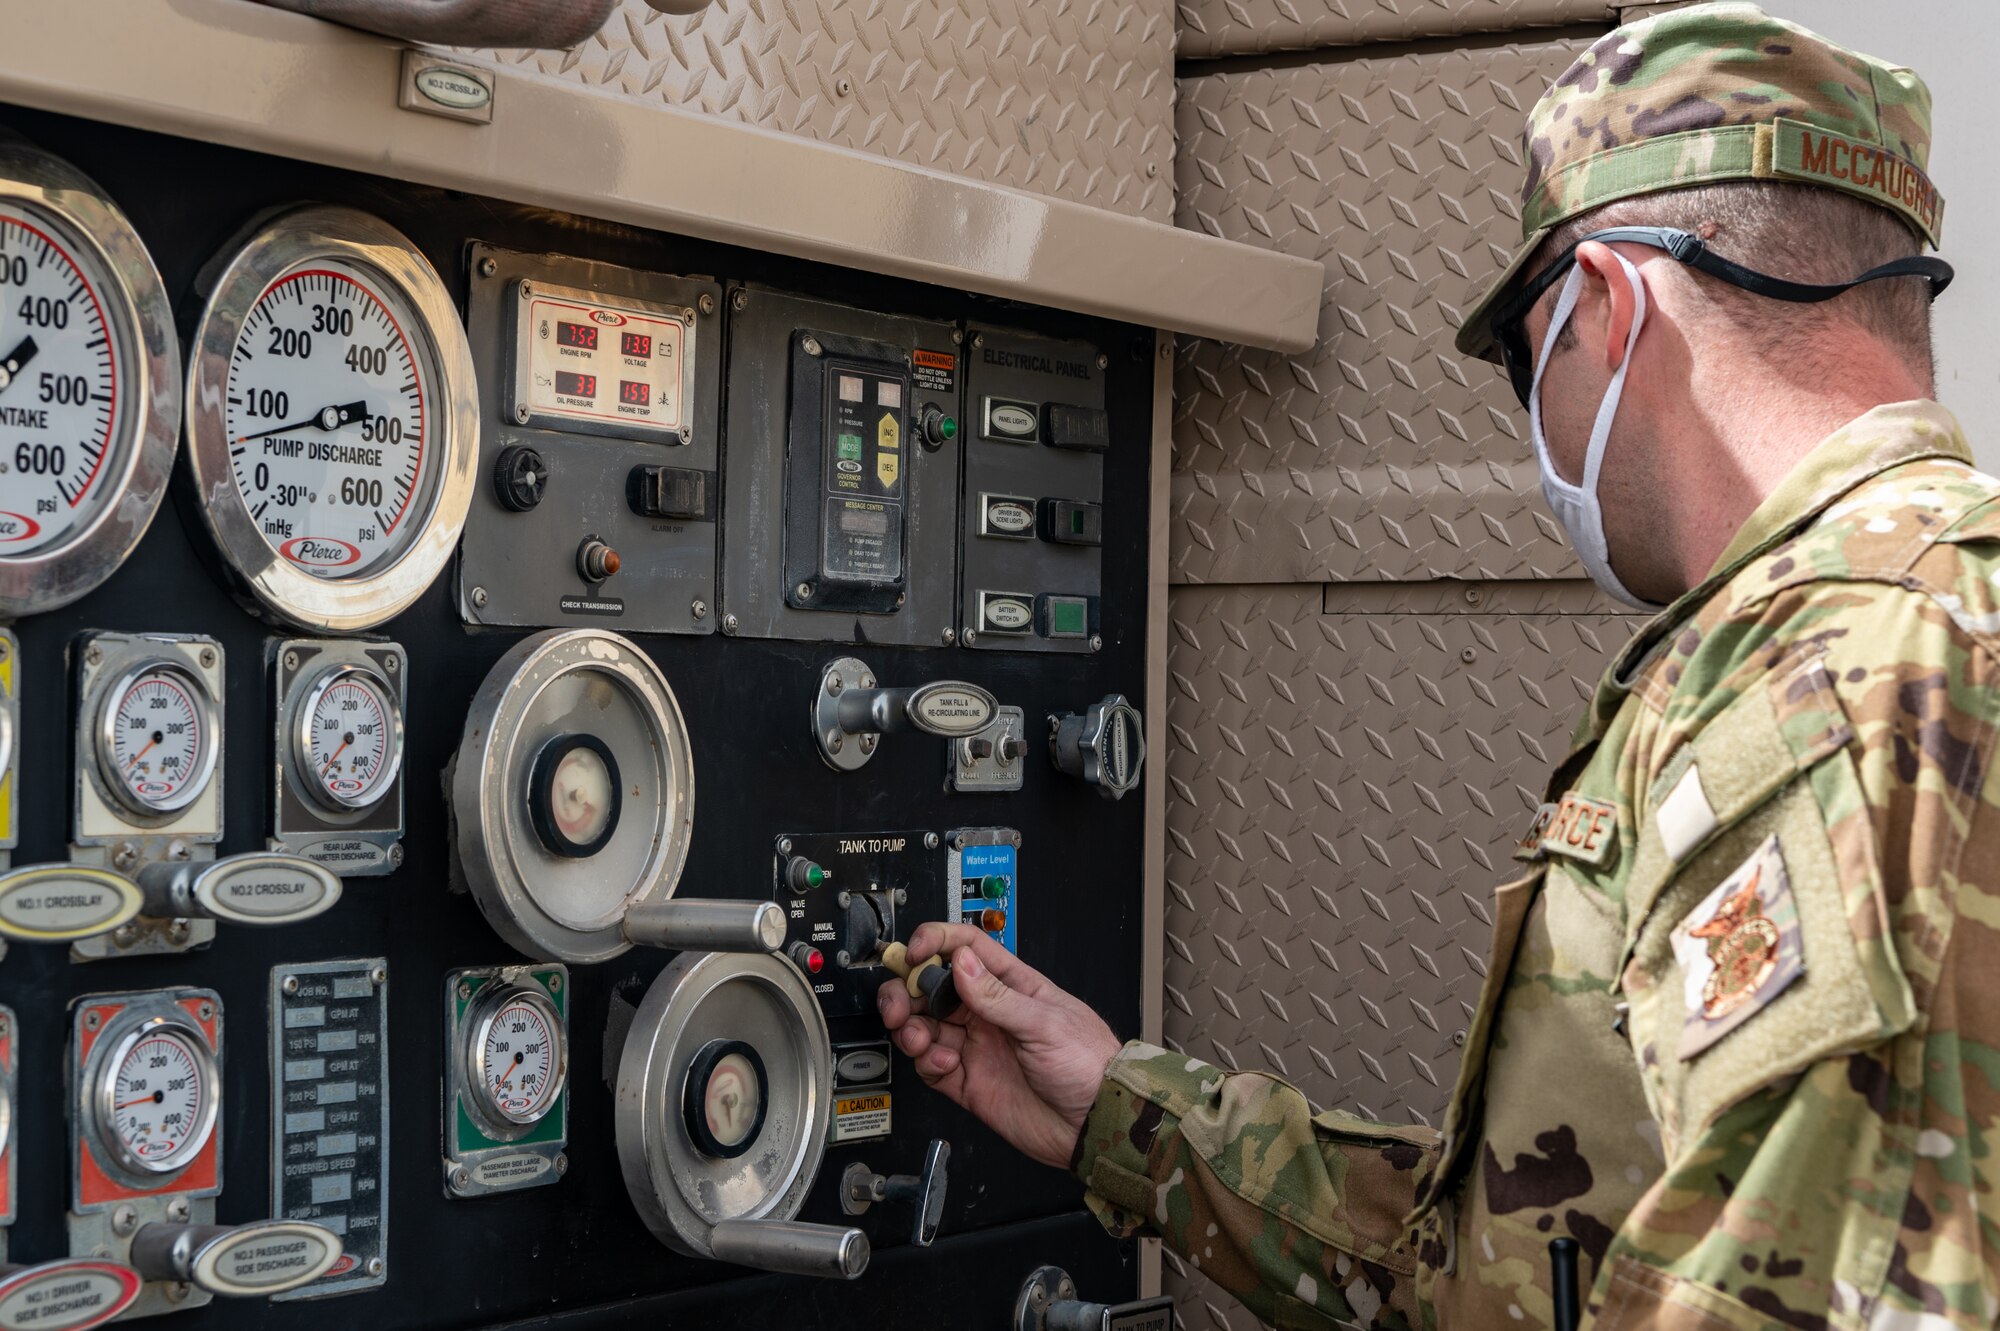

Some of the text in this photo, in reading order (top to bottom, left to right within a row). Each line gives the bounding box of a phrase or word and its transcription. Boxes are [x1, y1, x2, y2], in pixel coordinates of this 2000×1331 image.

[428, 78, 481, 97] NO.2 CROSSLAY
[1801, 131, 1937, 231] MCCAUGHEY
[0, 253, 27, 286] 00
[18, 295, 68, 330] 400
[597, 312, 619, 324] Pierce
[311, 304, 353, 337] 300
[569, 325, 596, 347] 752
[268, 326, 311, 359] 200
[625, 336, 650, 355] 13.9
[560, 347, 592, 359] ENGINE RPM
[345, 344, 387, 376] 400
[624, 358, 648, 368] VOLTAGE
[921, 353, 953, 367] WARNING
[983, 349, 1091, 380] ELECTRICAL PANEL
[912, 373, 952, 385] THROTTLE UNLESS
[39, 372, 88, 406] 500
[576, 376, 596, 395] 33
[624, 383, 649, 402] 159
[246, 388, 289, 420] 100
[556, 396, 594, 408] OIL PRESSURE
[617, 405, 651, 416] ENGINE TEMP
[0, 407, 48, 429] NTAKE
[844, 419, 863, 427] PRESSURE
[998, 415, 1028, 426] PANEL LIGHTS
[361, 414, 402, 445] 500
[883, 428, 894, 437] INC
[263, 437, 383, 467] PUMP DISCHARGE
[842, 442, 858, 452] MODE
[15, 442, 65, 476] 600
[882, 464, 893, 472] DEC
[254, 462, 269, 492] 0
[837, 473, 861, 481] GOVERNOR
[838, 480, 859, 489] CONTROL
[341, 476, 383, 508] 600
[37, 496, 57, 515] psi
[845, 501, 866, 509] MESSAGE
[998, 509, 1013, 517] DRIVER
[996, 516, 1009, 524] SCENE
[264, 517, 293, 539] inHg
[359, 525, 376, 542] psi
[651, 524, 684, 534] ALARM OFF
[298, 540, 343, 560] Pierce
[561, 601, 622, 611] CHECK TRANSMISSION
[998, 606, 1017, 614] BATTERY
[150, 698, 168, 709] 200
[342, 700, 358, 711] 200
[928, 709, 980, 717] RE-CIRCULATING LINE
[129, 718, 147, 729] 100
[166, 723, 184, 734] 300
[324, 719, 339, 730] 100
[357, 724, 373, 735] 300
[162, 756, 179, 768] 400
[323, 752, 329, 763] 0
[353, 756, 369, 767] 400
[323, 843, 361, 851] REAR LARGE
[840, 838, 906, 854] TANK TO PUMP
[341, 852, 376, 860] DISCHARGE
[966, 854, 1009, 865] Water Level
[822, 870, 832, 878] PEN
[230, 882, 305, 897] NO.2 CROSSLAY
[962, 884, 975, 894] Full
[45, 895, 103, 909] CROSSLAY
[790, 900, 805, 908] VALVE
[790, 910, 804, 918] OPEN
[814, 923, 833, 931] MANUAL
[812, 932, 836, 942] OVERRIDE
[297, 987, 314, 997] JOB
[315, 986, 330, 996] NO.
[814, 983, 834, 993] CLOSED
[330, 1008, 359, 1019] GPM AT
[512, 1023, 526, 1033] 200
[289, 1040, 302, 1050] 150
[303, 1039, 317, 1049] PSI
[358, 1033, 376, 1044] RPM
[495, 1042, 509, 1053] 100
[525, 1043, 540, 1054] 300
[150, 1056, 167, 1069] 200
[329, 1060, 359, 1072] GPM AT
[129, 1079, 147, 1092] 100
[167, 1078, 185, 1091] 300
[495, 1074, 500, 1085] 0
[521, 1074, 536, 1085] 400
[303, 1091, 317, 1101] PSI
[358, 1085, 376, 1095] RPM
[850, 1097, 884, 1111] CAUTION
[130, 1116, 136, 1128] 0
[163, 1112, 181, 1125] 400
[330, 1112, 359, 1124] GPM AT
[303, 1143, 317, 1152] PSI
[358, 1136, 376, 1147] RPM
[285, 1159, 356, 1176] GOVERNED SPEED
[481, 1158, 541, 1171] PASSENGER SIDE LARGE
[483, 1166, 538, 1179] DIAMETER DISCHARGE
[358, 1179, 376, 1191] RPM
[289, 1206, 320, 1219] PUMP IN
[350, 1216, 379, 1228] DIRECT
[234, 1242, 307, 1261] NO.2 PASSENGER
[235, 1256, 307, 1276] SIDE DISCHARGE
[52, 1280, 92, 1298] DRIVER
[14, 1293, 102, 1324] SIDE DISCHARGE
